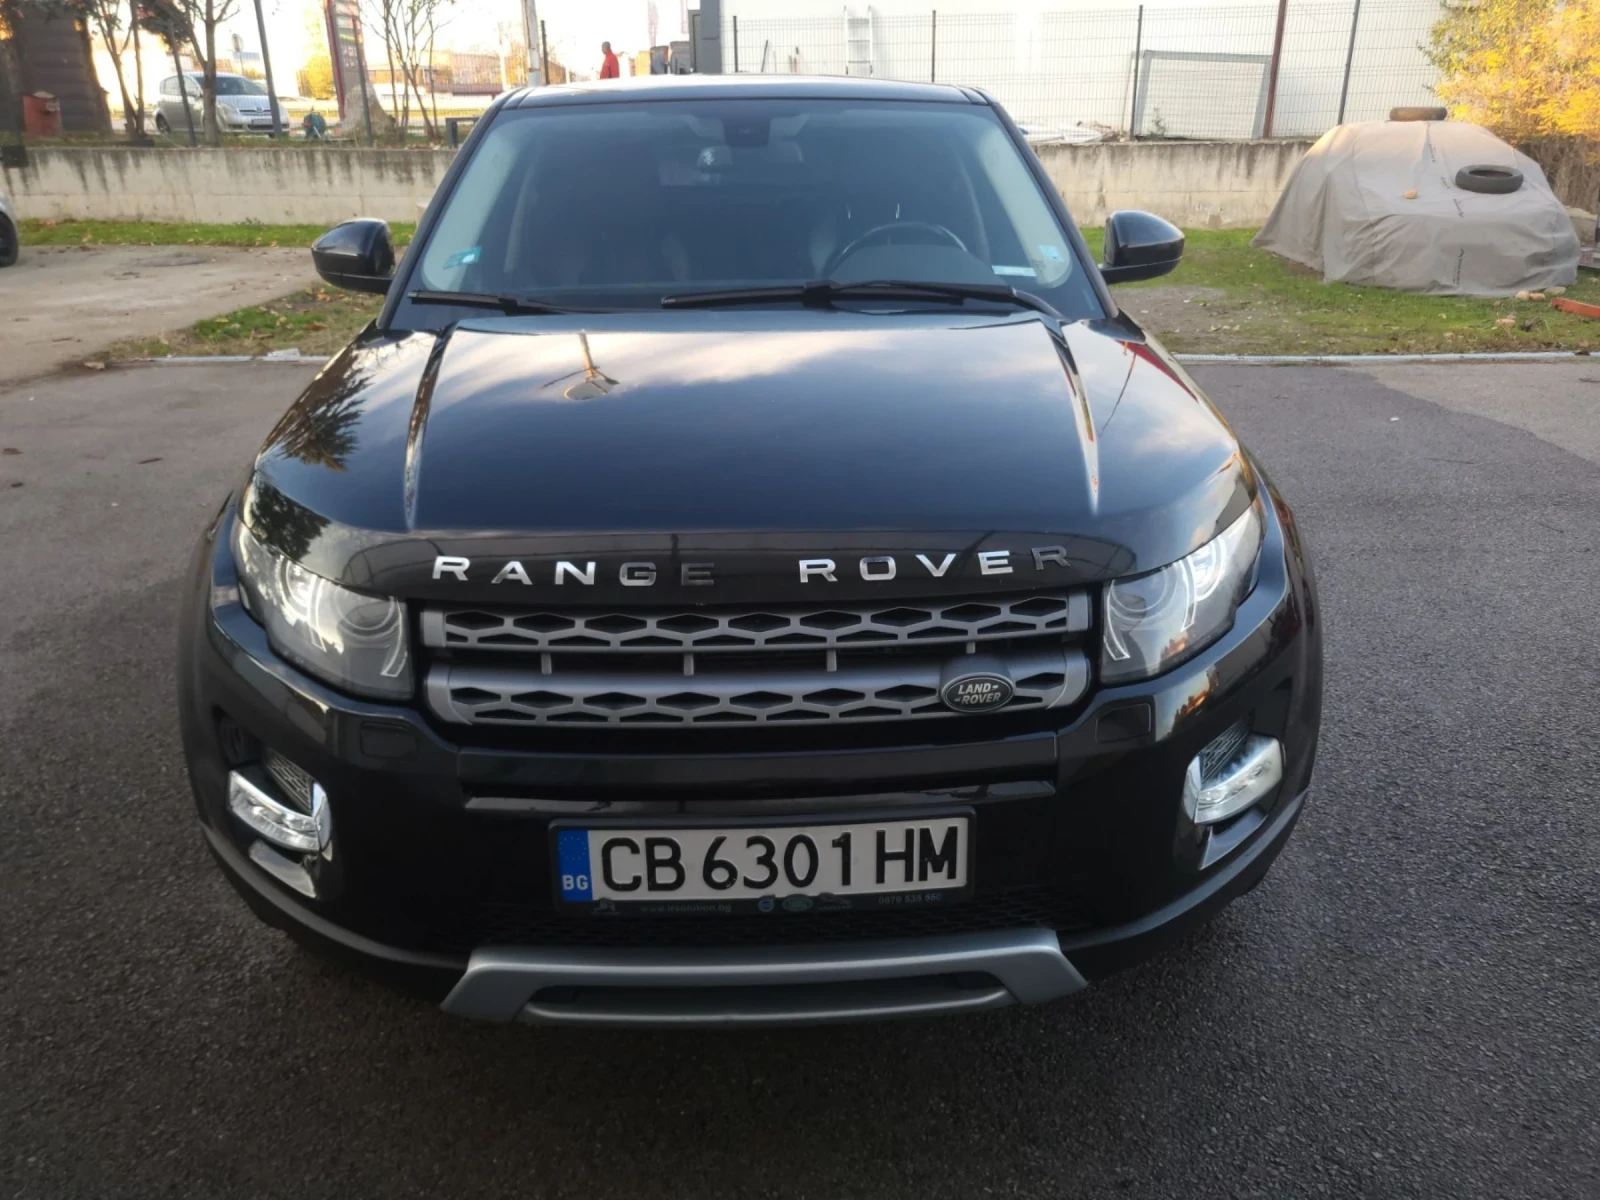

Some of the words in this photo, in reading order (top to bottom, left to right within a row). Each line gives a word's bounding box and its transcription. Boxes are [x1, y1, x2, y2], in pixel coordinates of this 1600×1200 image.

[431, 556, 716, 587] RANGE
[798, 546, 1071, 583] ROVER
[958, 682, 992, 695] LAND
[961, 692, 1001, 705] ROVER
[600, 836, 686, 893] CB
[702, 832, 853, 890] 6301
[876, 825, 959, 884] HM
[562, 874, 589, 891] BG
